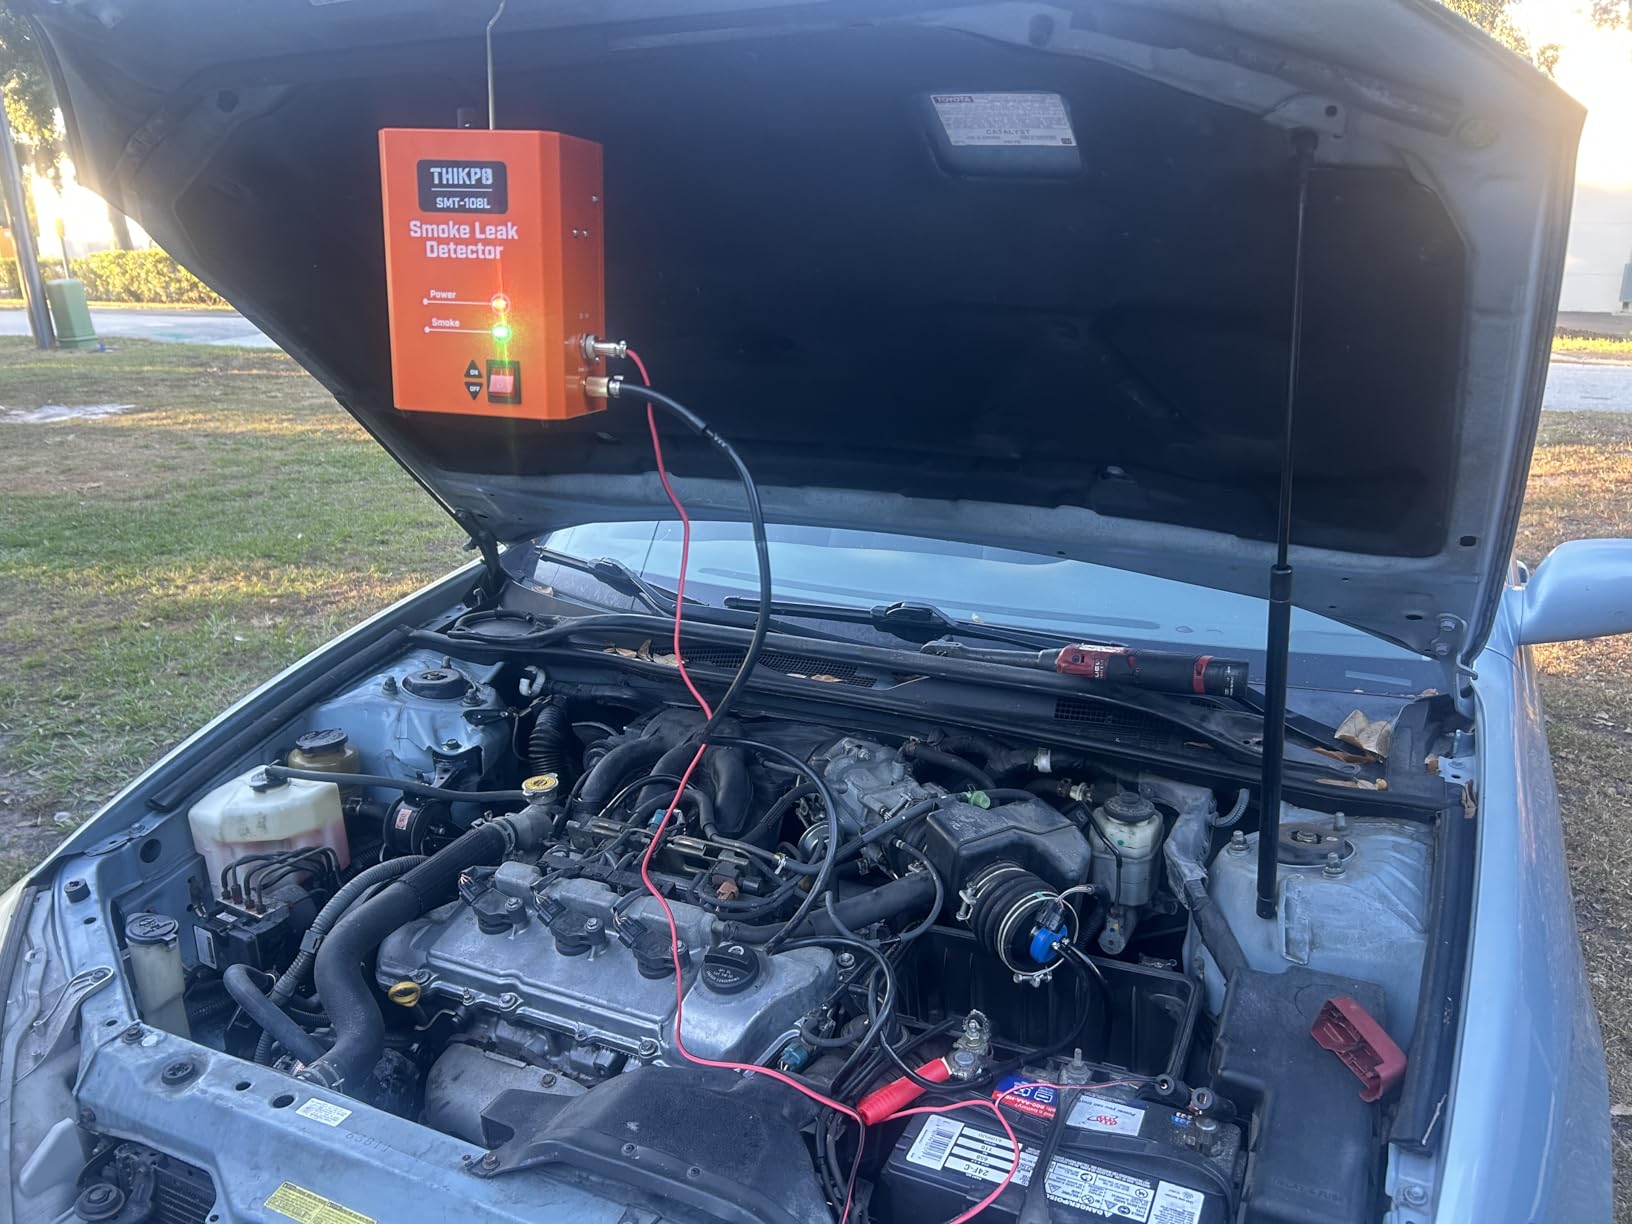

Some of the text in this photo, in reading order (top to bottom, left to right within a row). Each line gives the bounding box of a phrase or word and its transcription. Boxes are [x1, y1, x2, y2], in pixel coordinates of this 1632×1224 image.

[436, 197, 491, 210] SMT-108L
[409, 220, 518, 240] Smoke Leak
[425, 240, 504, 260] Detector
[430, 290, 457, 300] Power
[431, 318, 460, 328] Smoke
[963, 1163, 989, 1177] 24F-C
